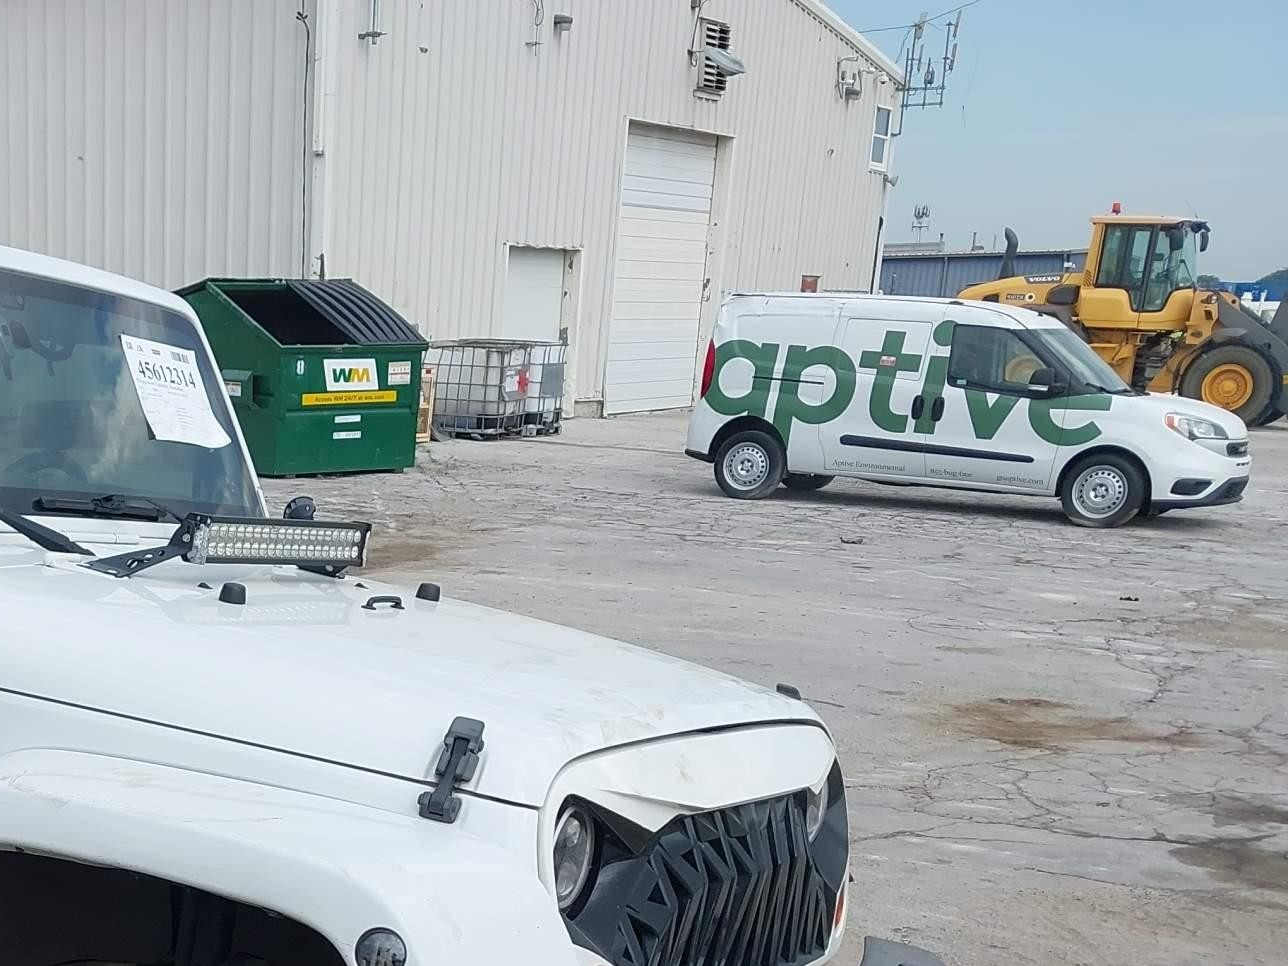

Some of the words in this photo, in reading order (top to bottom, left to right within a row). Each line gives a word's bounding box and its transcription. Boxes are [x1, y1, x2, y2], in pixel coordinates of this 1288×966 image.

[138, 360, 196, 389] 45612314
[331, 367, 371, 383] WM
[832, 459, 854, 468] Aptive
[855, 460, 906, 472] Environmental
